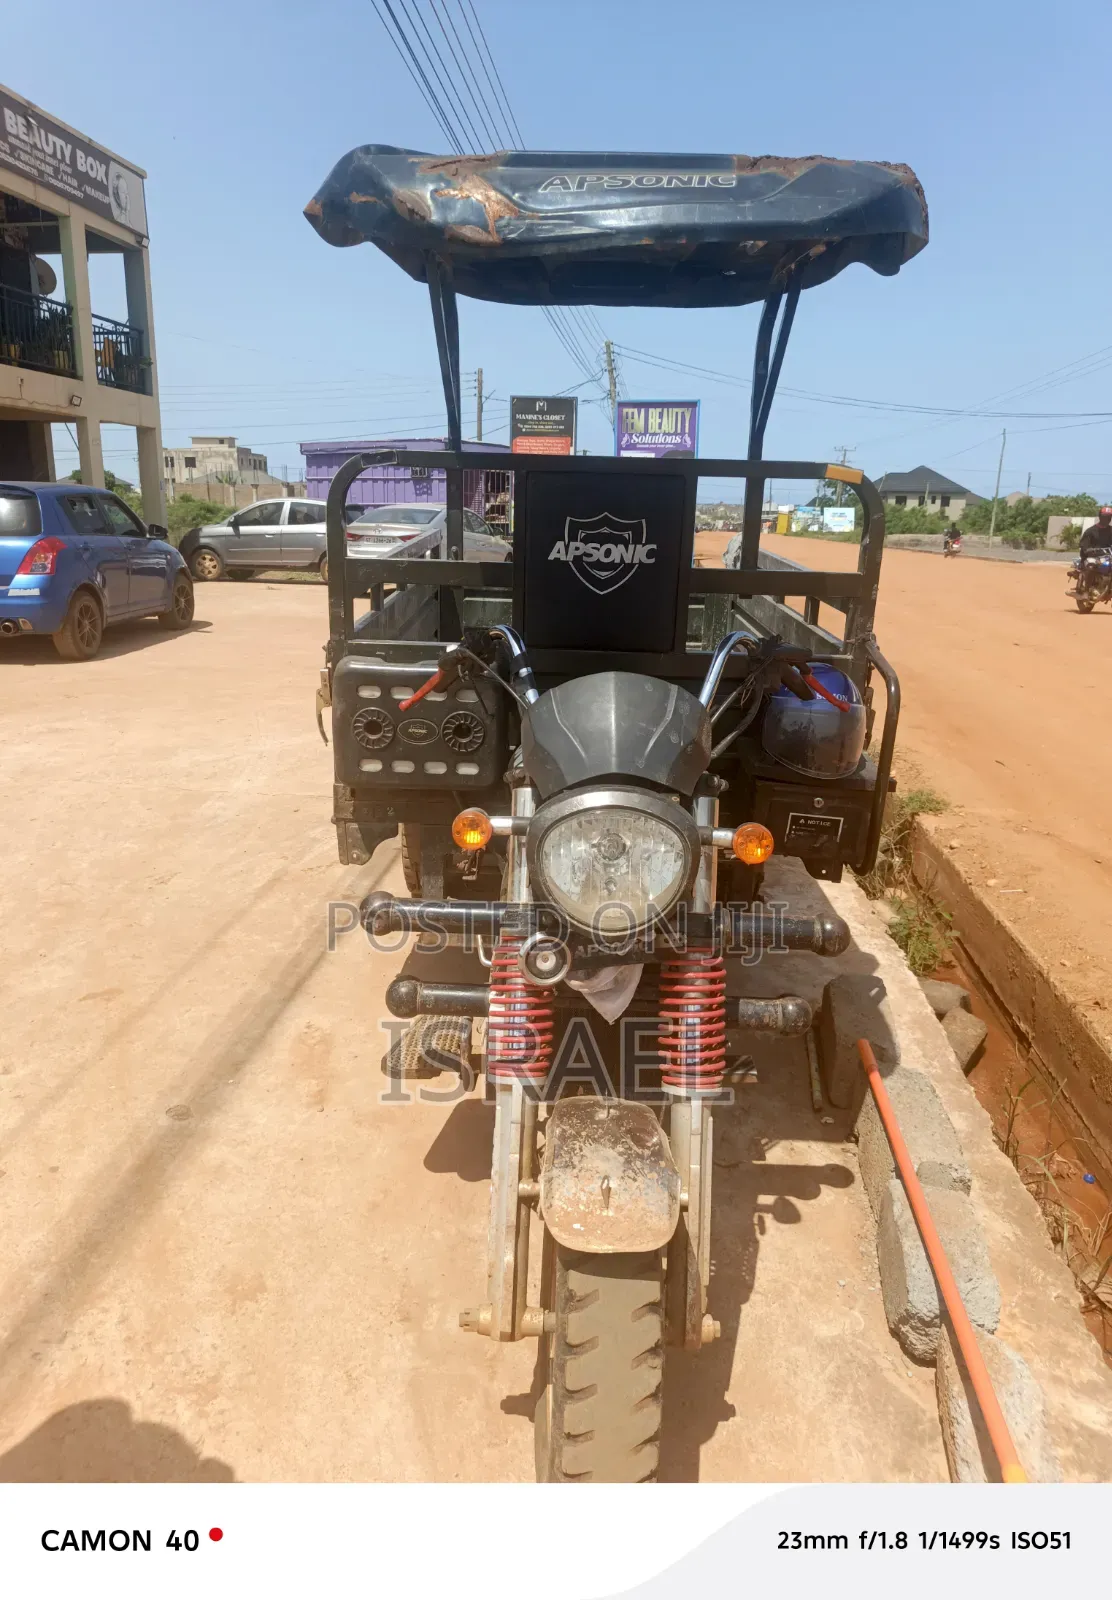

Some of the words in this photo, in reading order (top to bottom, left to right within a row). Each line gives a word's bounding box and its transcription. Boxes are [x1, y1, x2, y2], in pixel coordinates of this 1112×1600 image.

[4, 107, 73, 164] BEAUTY
[76, 148, 108, 185] BOX
[538, 174, 737, 193] APSONIC
[621, 407, 645, 434] FEM
[648, 407, 692, 434] BEAUTY
[631, 433, 682, 444] Solutions
[547, 540, 658, 564] APSONIC
[807, 819, 832, 827] NOTICE
